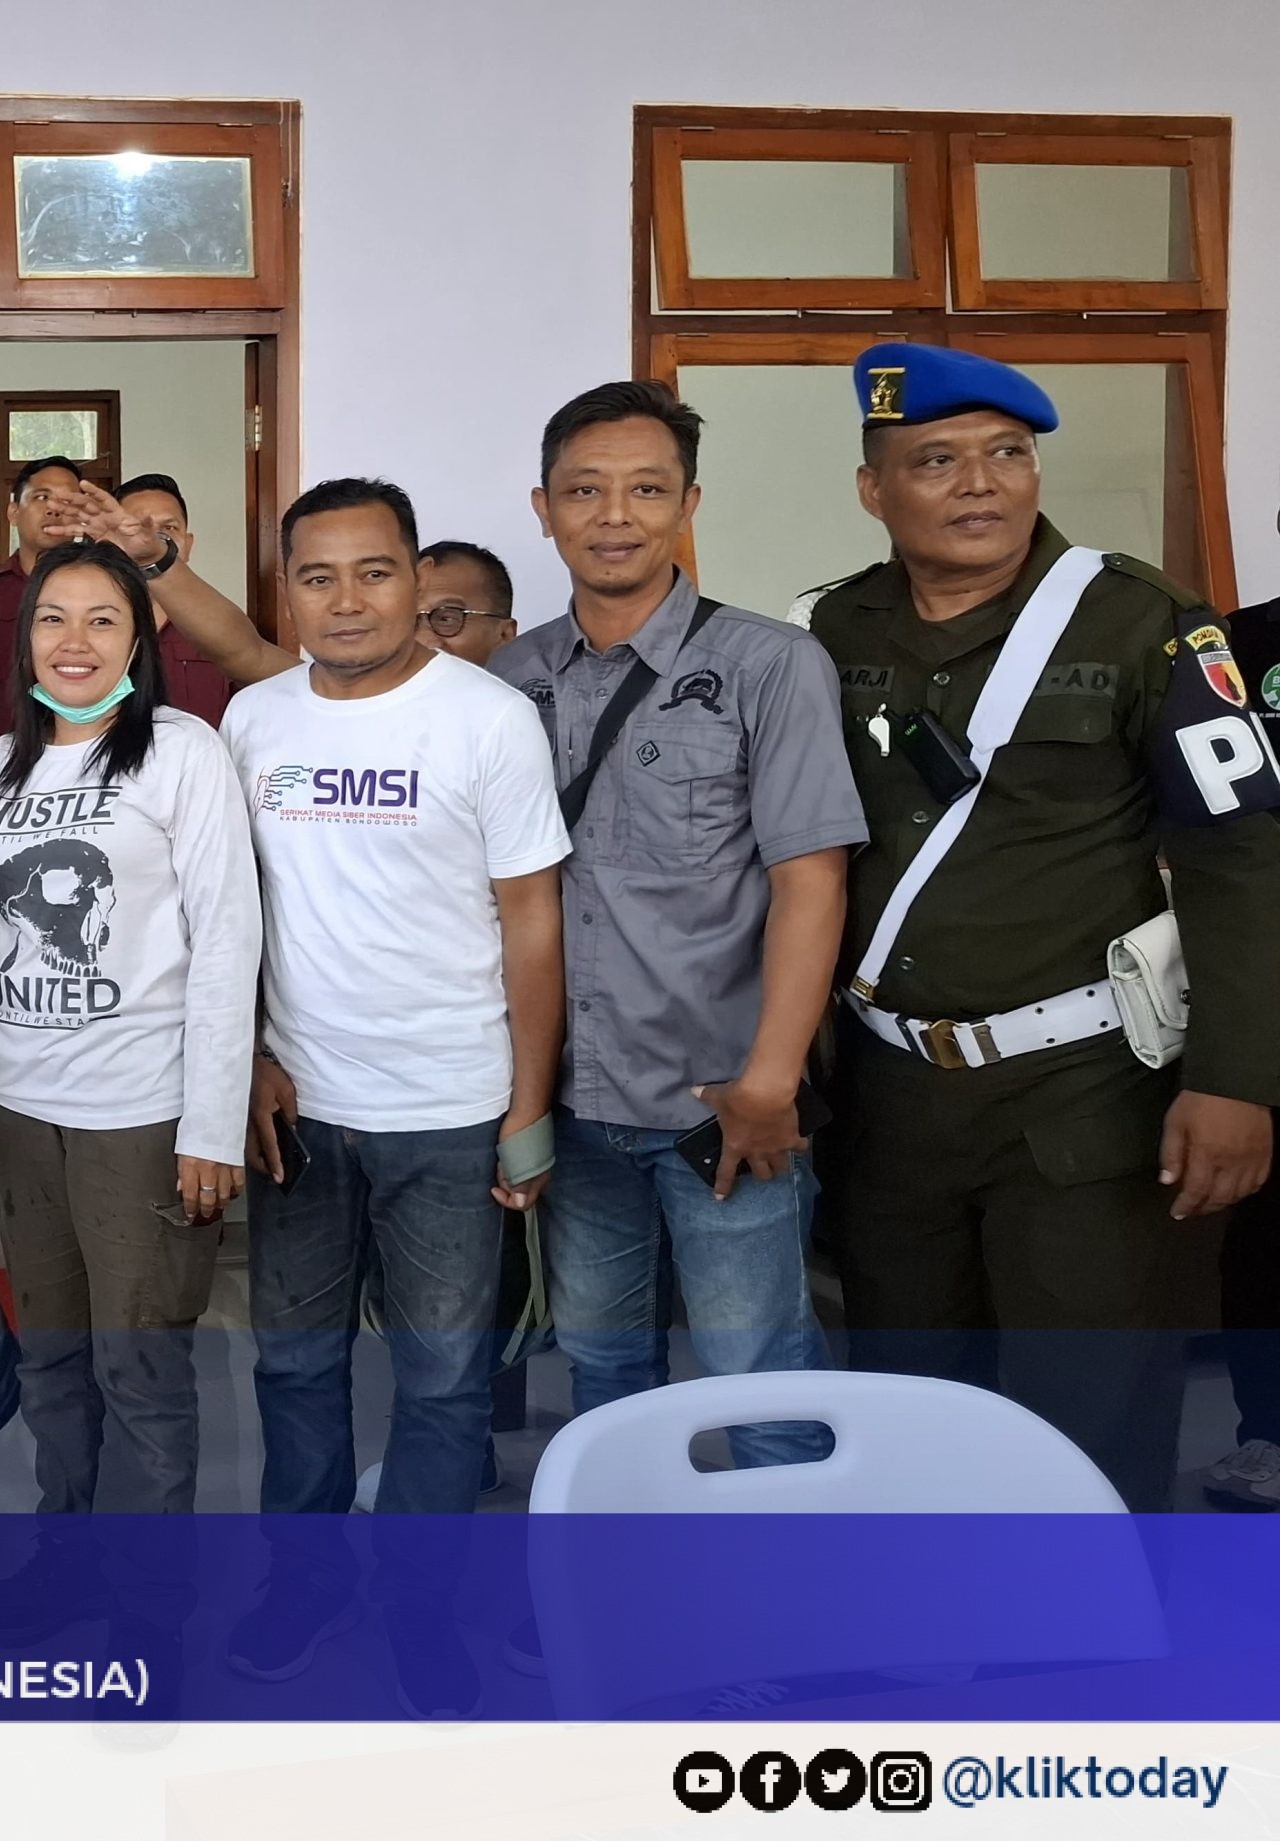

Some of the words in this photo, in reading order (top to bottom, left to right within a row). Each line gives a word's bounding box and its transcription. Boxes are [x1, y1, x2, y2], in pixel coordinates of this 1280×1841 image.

[312, 768, 419, 808] SMSI
[315, 810, 340, 818] MEDIA
[367, 812, 417, 820] INDONESIA
[346, 819, 417, 827] BONDOWOSO
[60, 826, 98, 836] FALL
